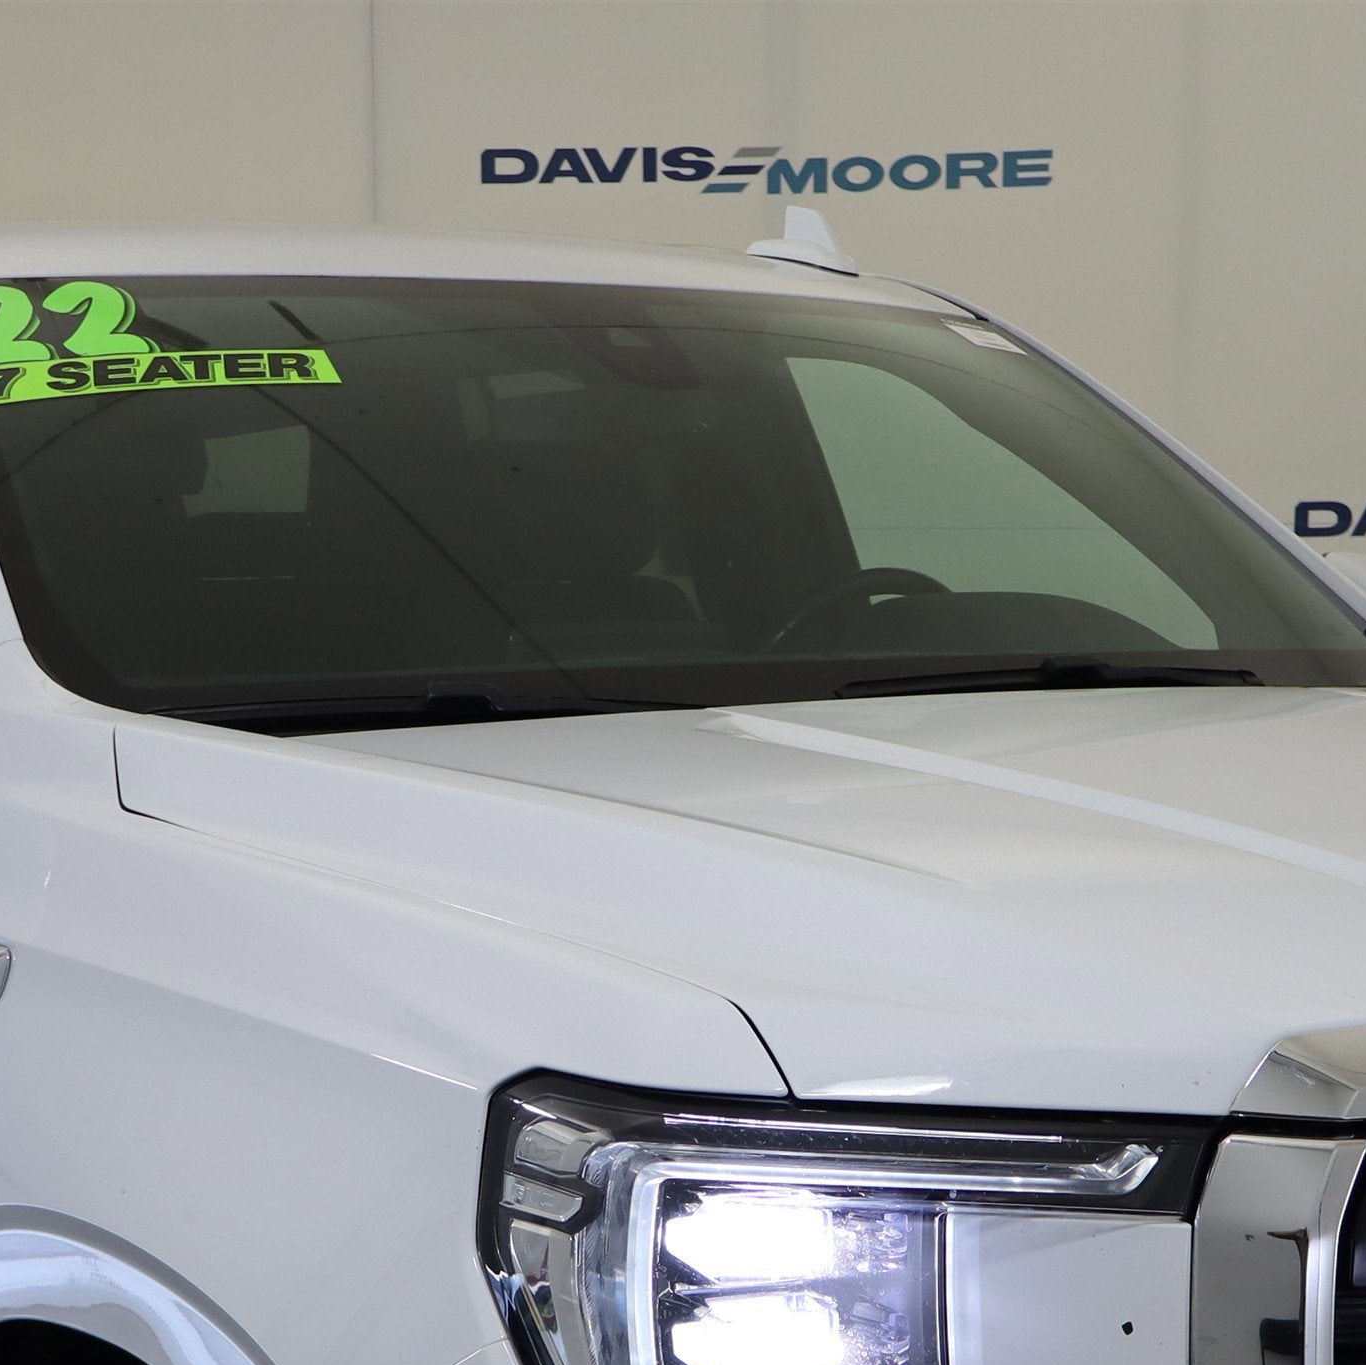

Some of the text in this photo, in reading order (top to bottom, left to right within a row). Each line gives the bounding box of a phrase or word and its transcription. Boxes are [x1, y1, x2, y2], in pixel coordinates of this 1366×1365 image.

[480, 146, 1054, 195] DAVIS MOORE
[46, 352, 320, 392] SEATER
